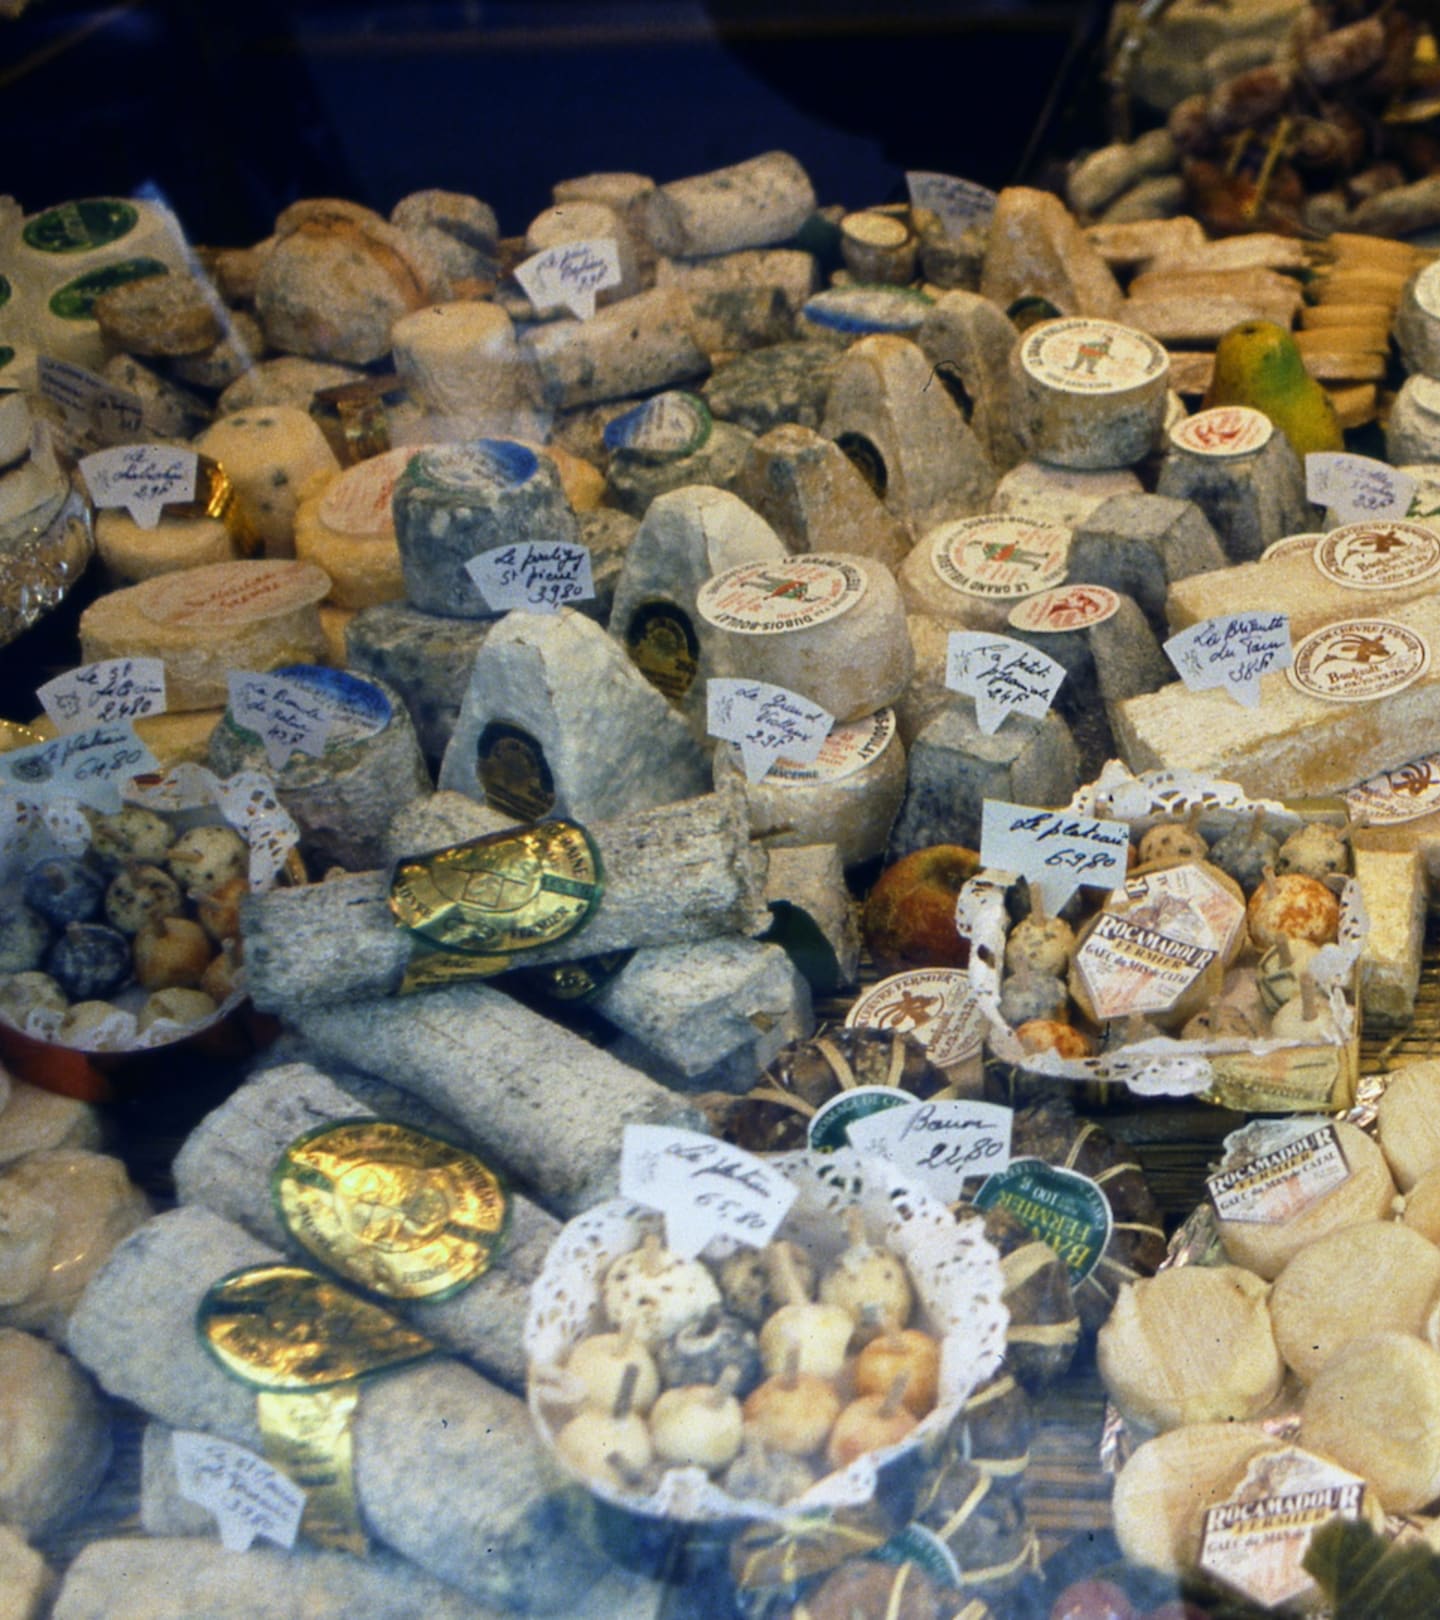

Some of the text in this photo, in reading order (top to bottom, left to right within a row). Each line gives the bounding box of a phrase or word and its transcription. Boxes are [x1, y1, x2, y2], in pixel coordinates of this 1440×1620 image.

[1094, 913, 1214, 970] ROCAMADOUR
[1209, 1126, 1335, 1197] ROCAMADOUR
[1206, 1484, 1363, 1532] ROCAMADOUR
